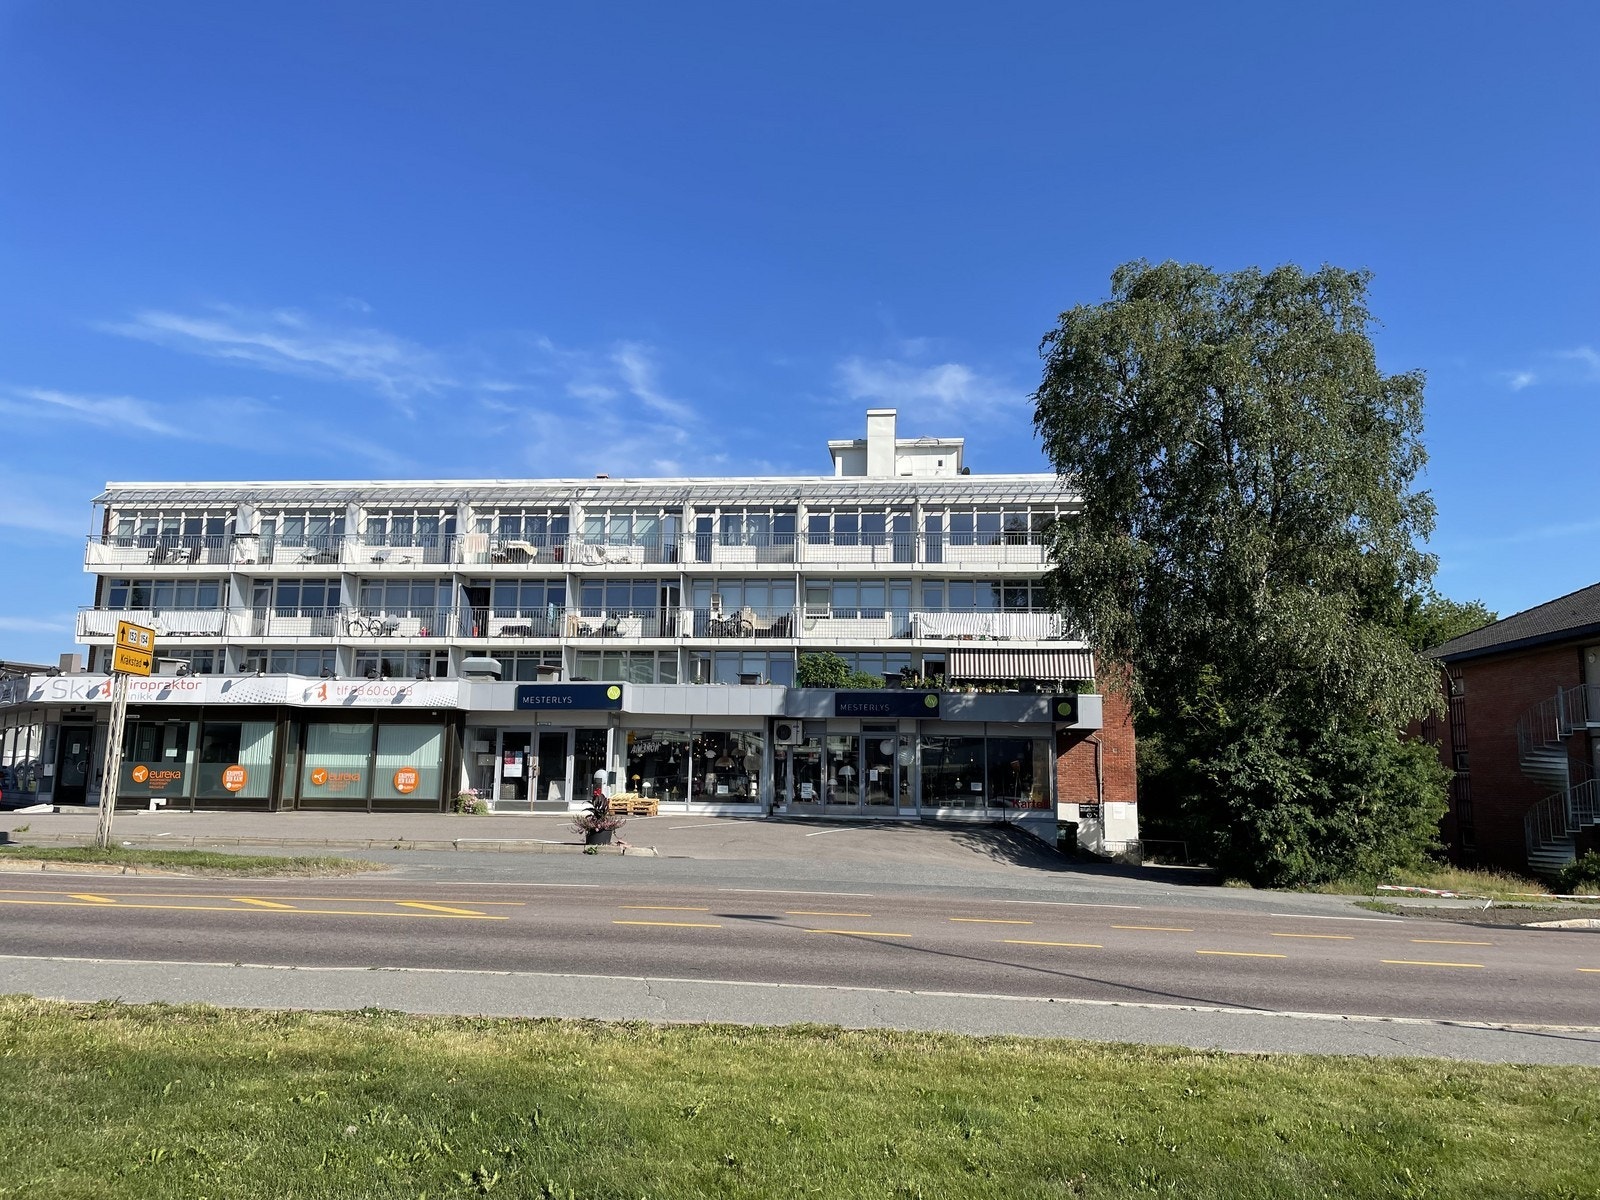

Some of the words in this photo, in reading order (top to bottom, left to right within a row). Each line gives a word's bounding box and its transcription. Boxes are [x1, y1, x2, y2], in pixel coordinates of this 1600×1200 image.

[129, 631, 137, 641] 152
[140, 634, 148, 644] 154
[129, 679, 202, 693] iropraktor
[336, 685, 349, 695] tlf
[366, 685, 380, 696] 60
[382, 685, 396, 696] 60
[127, 692, 153, 701] inikk
[522, 696, 572, 704] MESTERLYS
[840, 703, 890, 711] MESTERLYS
[149, 769, 181, 779] eureka
[328, 772, 360, 781] eureka
